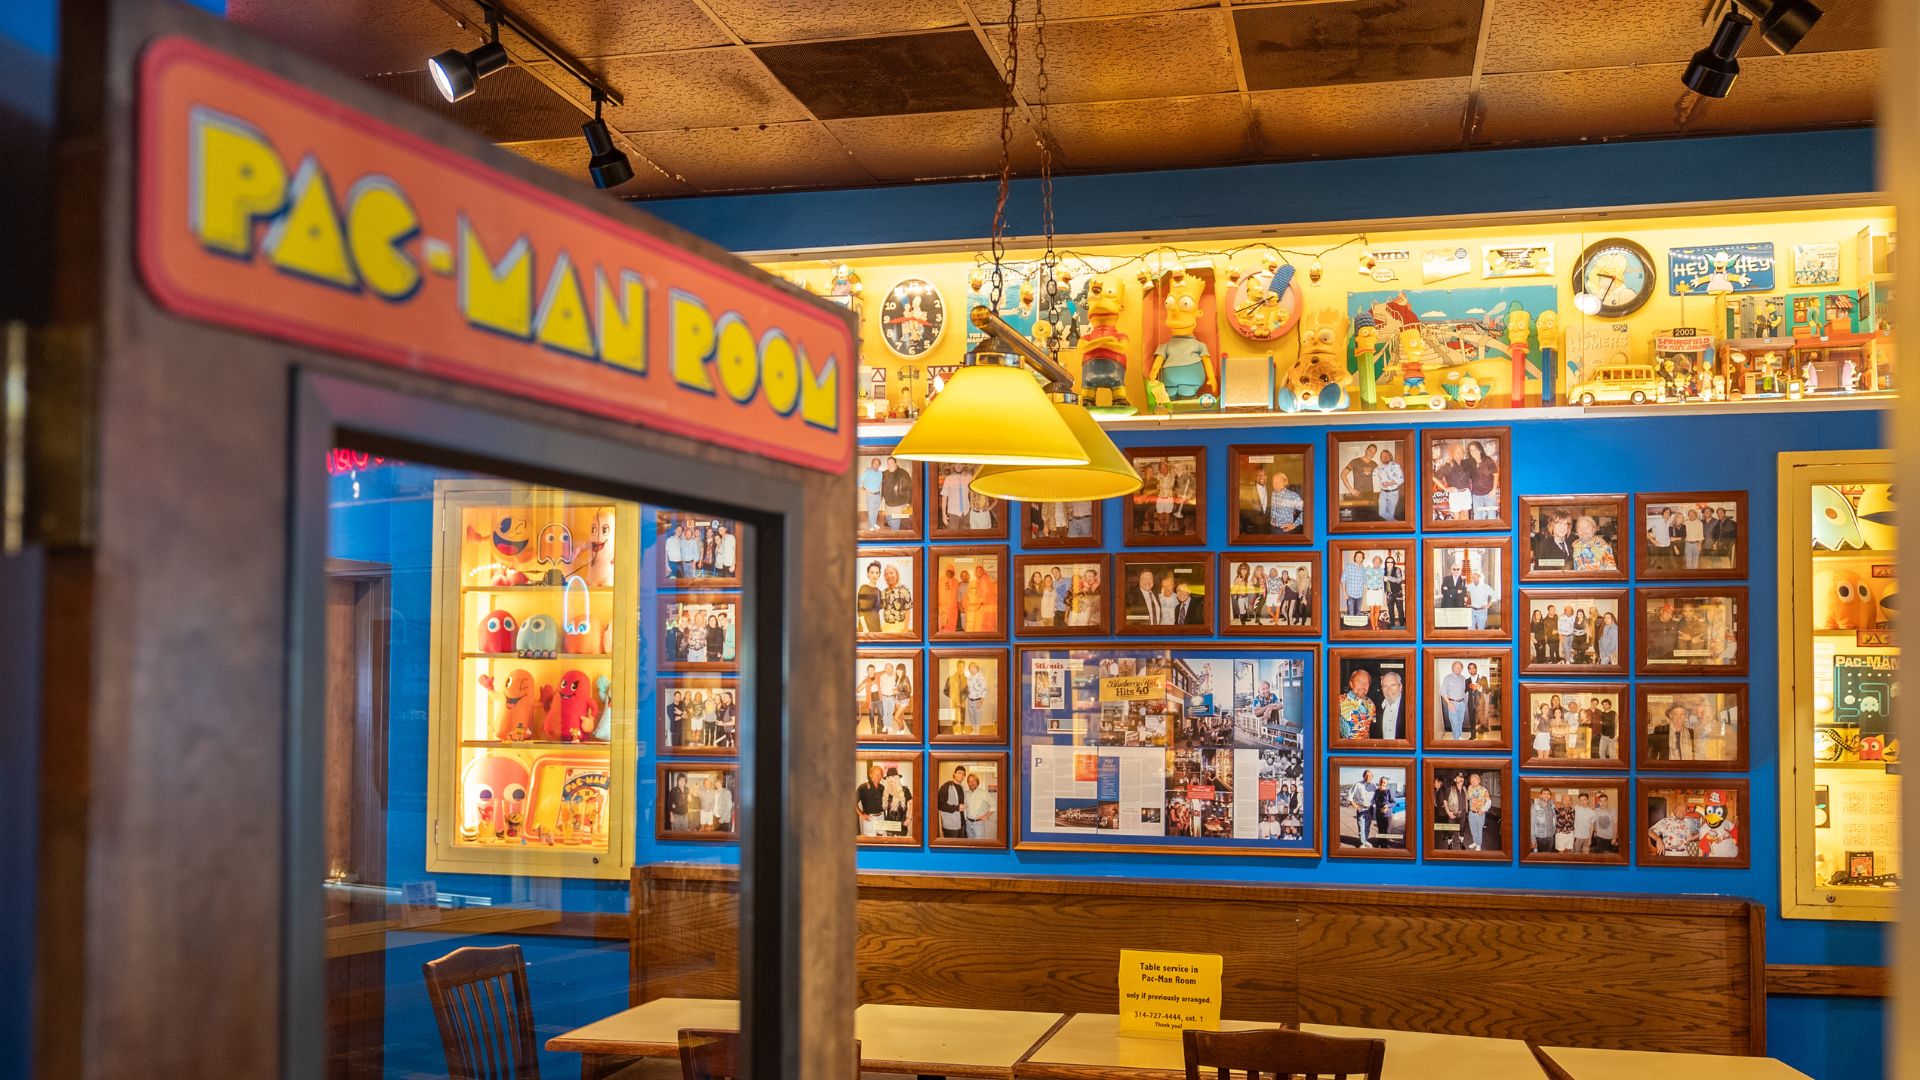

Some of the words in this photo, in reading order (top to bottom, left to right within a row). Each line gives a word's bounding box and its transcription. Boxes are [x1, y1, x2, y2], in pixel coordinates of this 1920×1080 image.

[188, 104, 650, 378] PAC-MAN
[669, 286, 839, 433] ROOM
[1673, 259, 1709, 278] HEY
[1735, 255, 1775, 274] HEY
[885, 302, 896, 310] 10
[934, 300, 941, 308] 2
[883, 315, 890, 324] 9
[935, 313, 942, 322] 3
[887, 329, 893, 337] 8
[932, 327, 939, 336] 4
[1674, 328, 1695, 337] 2003
[895, 341, 902, 350] 7
[924, 340, 930, 348] 5
[1657, 337, 1710, 346] SPRINGFIELD
[909, 347, 915, 355] 6
[1862, 634, 1889, 645] PAC
[1115, 687, 1135, 696] Hits
[1136, 686, 1149, 695] 40
[1140, 962, 1161, 971] Table
[1163, 965, 1189, 973] service
[1191, 965, 1199, 973] in
[1141, 974, 1173, 983] Pac-Man
[1175, 976, 1197, 985] Room
[1126, 992, 1140, 1001] only
[1147, 994, 1180, 1003] previously
[1181, 996, 1212, 1005] arranged.
[1134, 1011, 1183, 1022] 314-727-4444,
